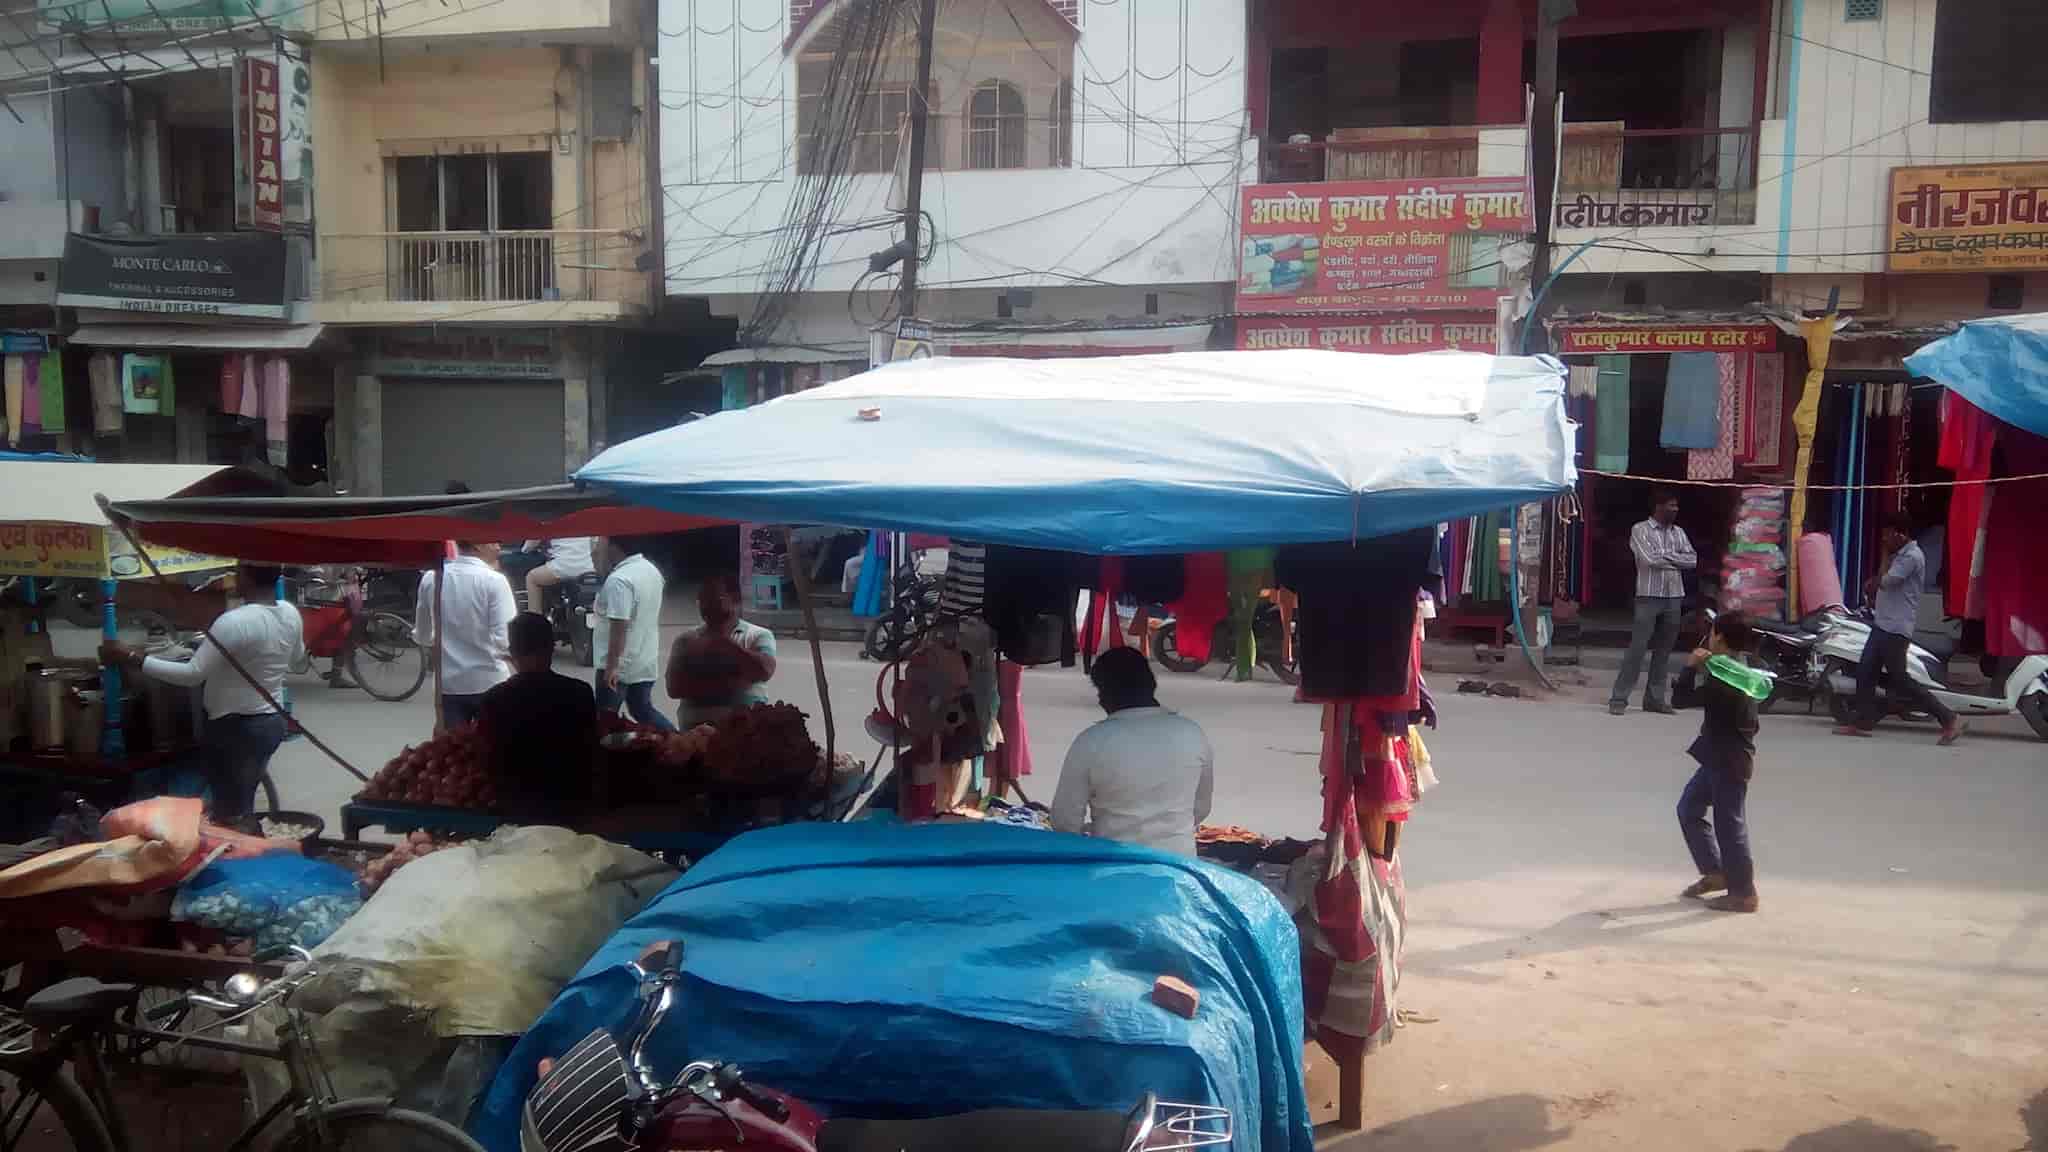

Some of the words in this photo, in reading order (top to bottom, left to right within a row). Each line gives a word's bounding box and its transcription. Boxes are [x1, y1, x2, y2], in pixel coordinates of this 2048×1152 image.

[254, 66, 280, 203] INDIAN
[1250, 191, 1322, 225] अवधेश
[1328, 194, 1390, 232] कुमार
[1396, 186, 1456, 220] संदीप
[1464, 190, 1526, 230] कुमार
[1897, 183, 2010, 229] नीरज
[1395, 231, 1408, 247] के
[112, 256, 160, 271] MONTE
[162, 259, 209, 273] CARLO
[1246, 323, 1311, 349] अवधेश
[1318, 325, 1374, 350] कुमार
[1380, 318, 1434, 344] संदीप
[1570, 330, 1651, 350] राजकुमार
[1711, 329, 1748, 346] स्टोर
